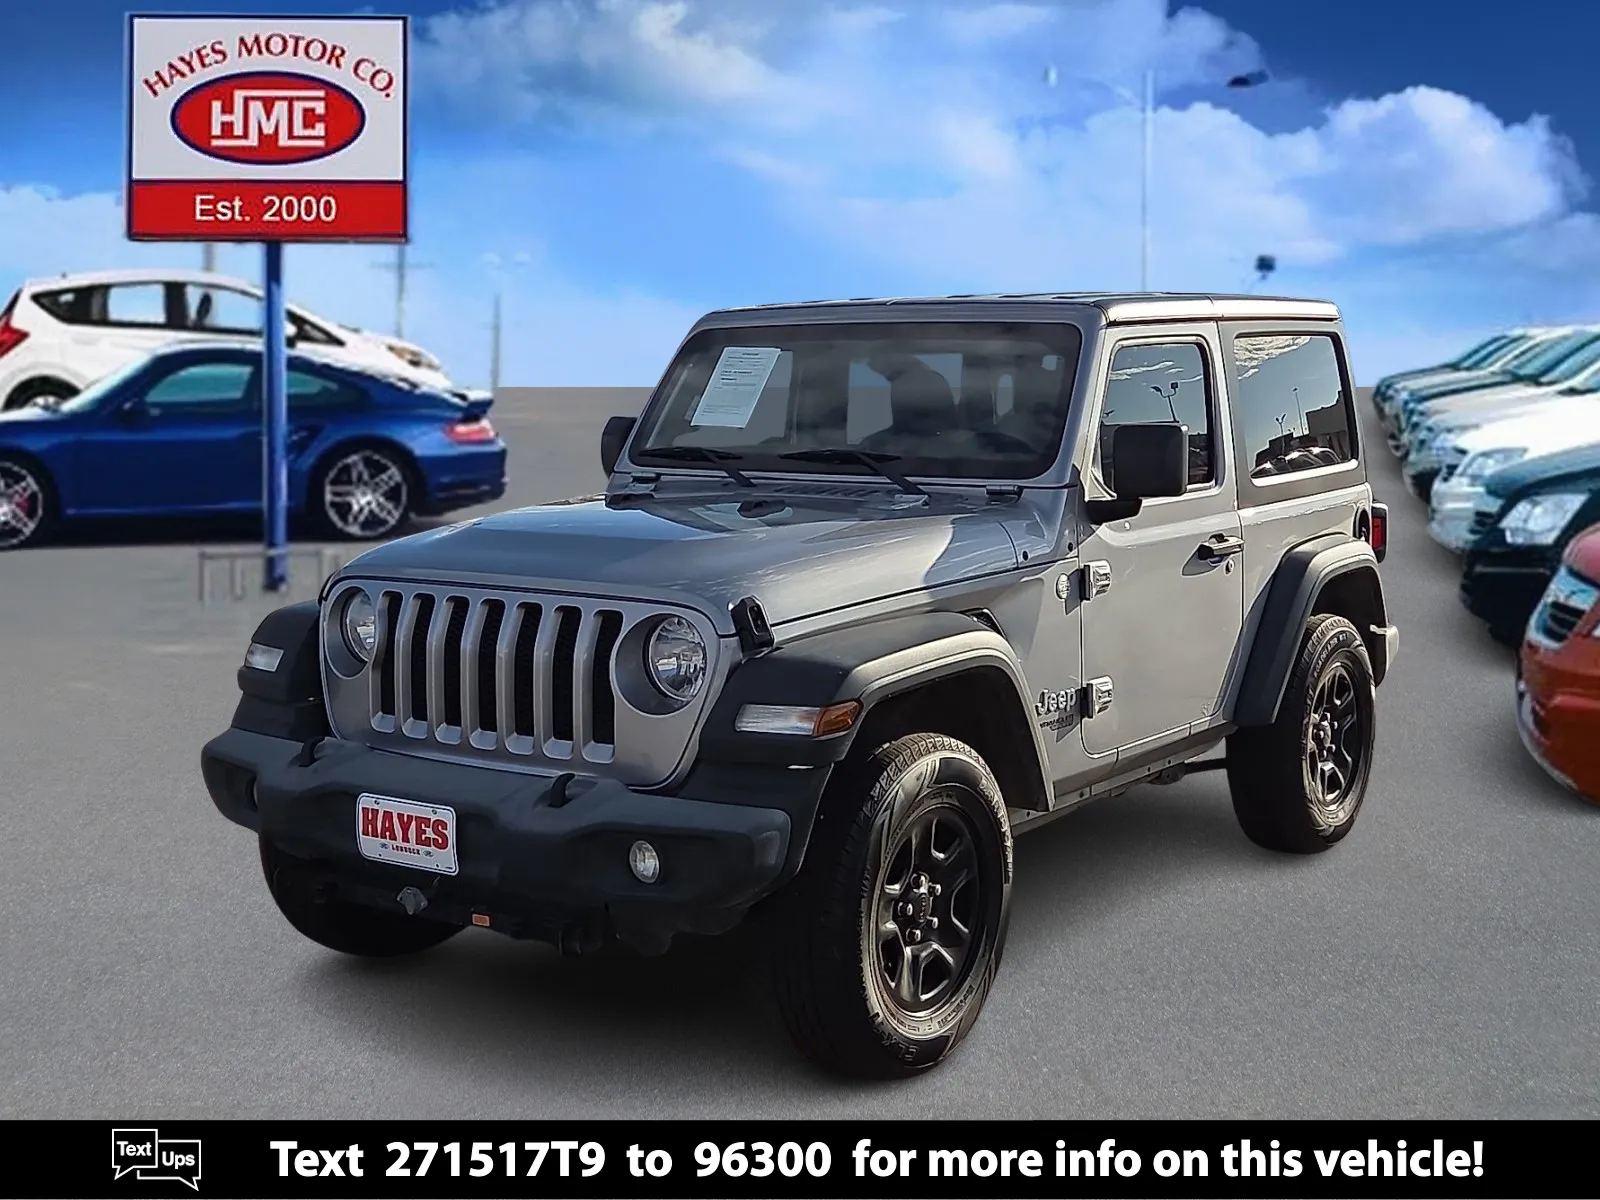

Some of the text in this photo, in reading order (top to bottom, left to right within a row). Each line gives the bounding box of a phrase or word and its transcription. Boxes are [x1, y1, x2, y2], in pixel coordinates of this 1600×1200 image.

[143, 33, 394, 98] HAYES MOTOR CO.
[210, 89, 326, 147] HMC
[195, 195, 337, 222] Est. 2000
[1035, 687, 1076, 715] Jeep
[361, 806, 449, 850] HAYES
